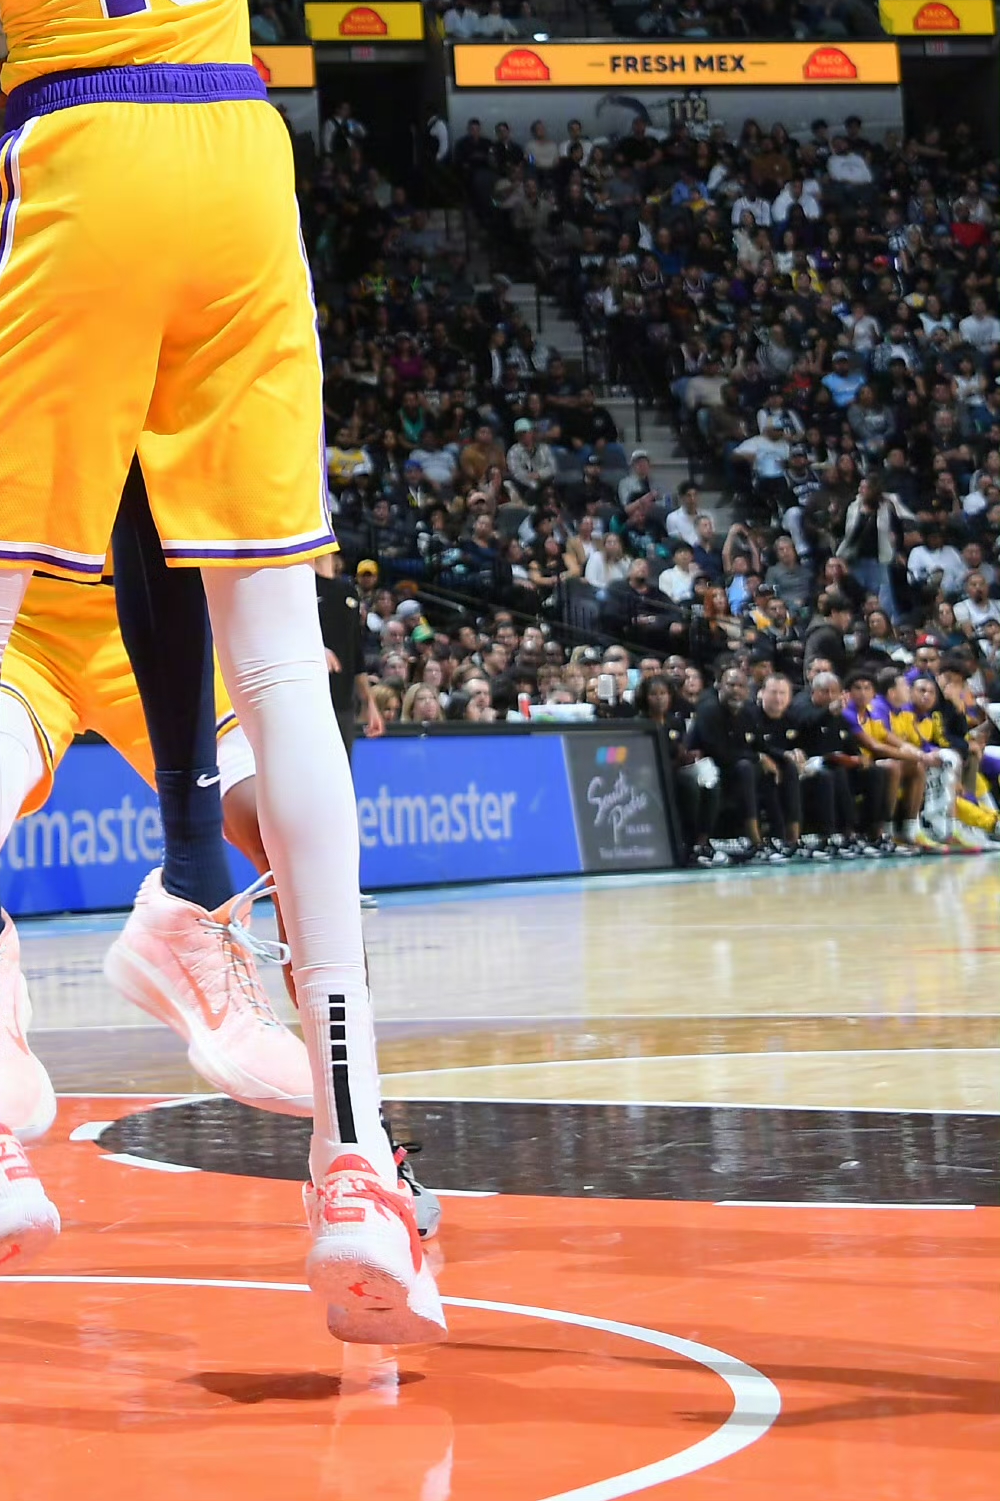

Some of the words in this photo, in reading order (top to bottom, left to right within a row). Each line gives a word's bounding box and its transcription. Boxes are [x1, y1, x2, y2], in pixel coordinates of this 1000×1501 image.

[610, 56, 685, 73] FRESH
[694, 55, 745, 72] MEX
[671, 100, 707, 120] 112
[357, 780, 517, 847] etmaster
